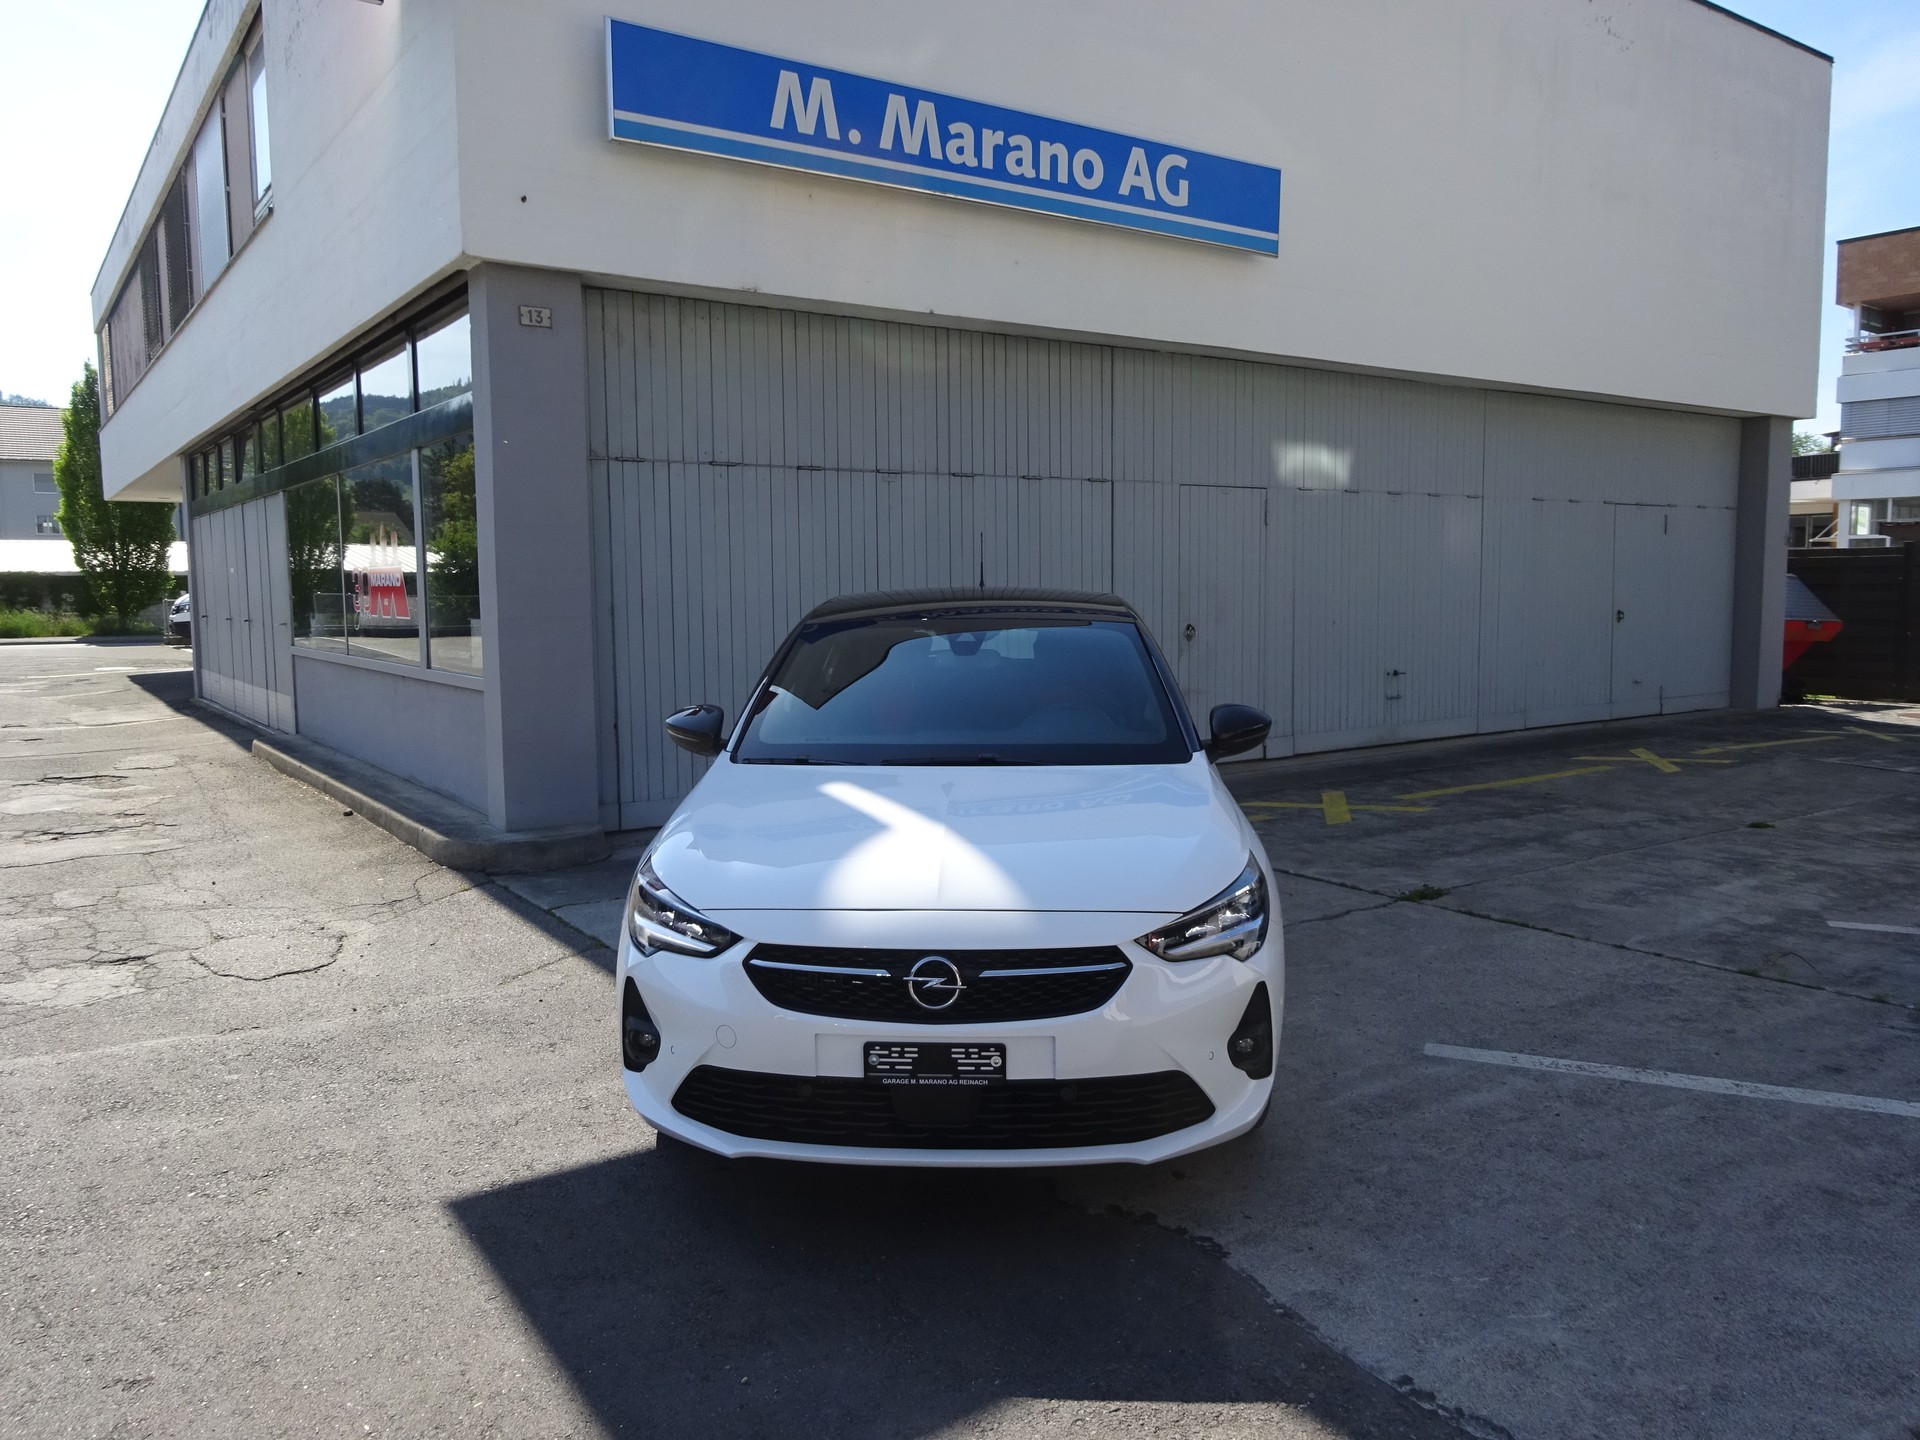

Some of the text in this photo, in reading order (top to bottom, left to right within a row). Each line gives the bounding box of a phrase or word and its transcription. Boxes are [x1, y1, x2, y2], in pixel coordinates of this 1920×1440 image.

[770, 69, 1189, 207] M. Marano AG
[528, 309, 543, 324] 13
[370, 573, 401, 587] MARANO
